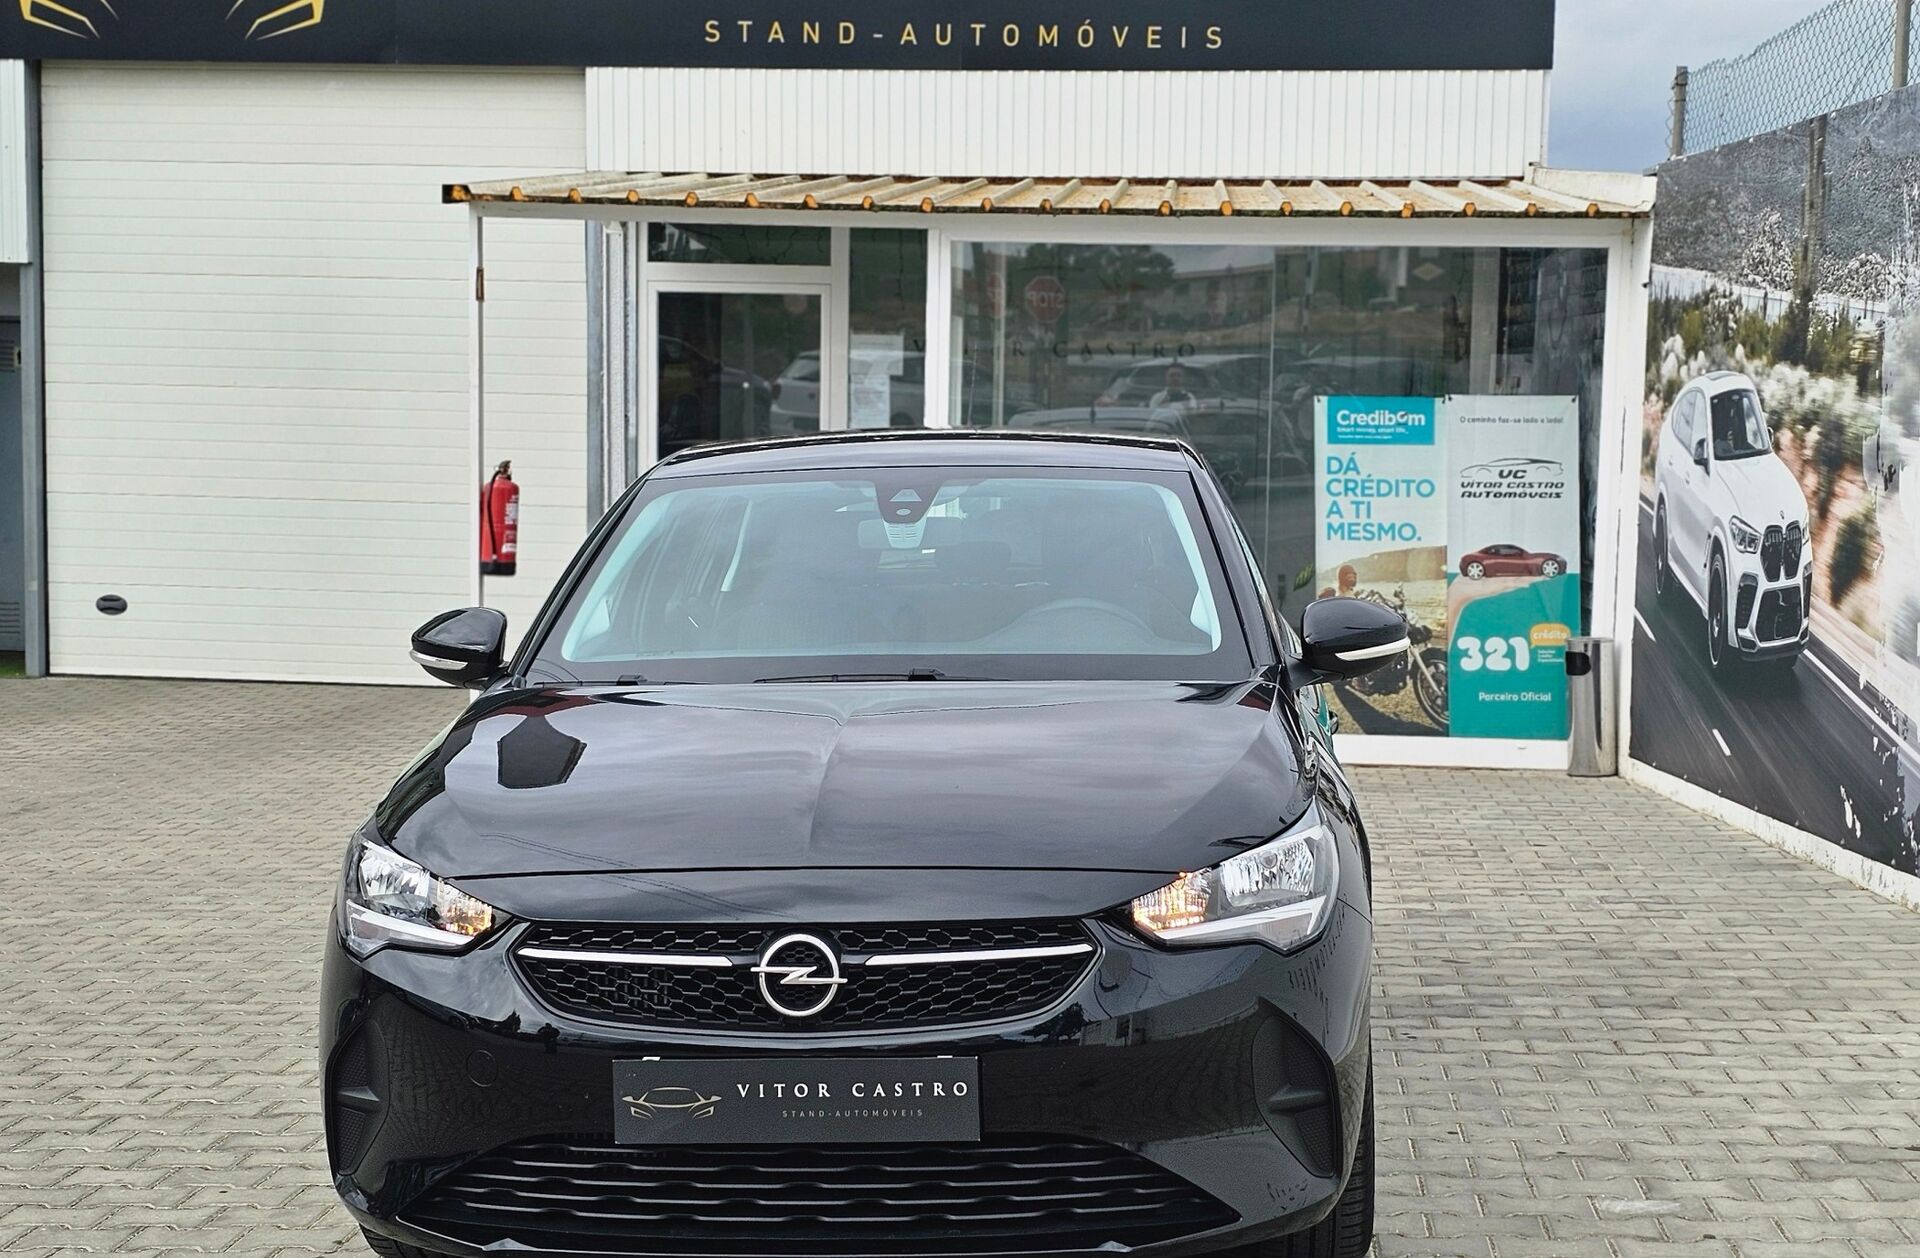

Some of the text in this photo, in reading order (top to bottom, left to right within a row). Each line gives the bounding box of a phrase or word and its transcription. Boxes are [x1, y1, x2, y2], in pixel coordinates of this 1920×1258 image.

[704, 19, 1223, 49] STAND-AUTOMÓVEIS
[1053, 341, 1196, 359] CASTRO
[1336, 409, 1426, 426] Credibom
[1326, 451, 1361, 475] DÁ
[1326, 474, 1436, 498] CRÉDITO
[1506, 481, 1565, 489] CASTRO
[1326, 500, 1372, 519] A TI
[1326, 522, 1422, 542] MESMO.
[1456, 636, 1530, 671] 321
[1478, 692, 1552, 702] Parceiro Oficial
[736, 1081, 969, 1098] VITOR CASTRO
[782, 1107, 924, 1118] STAND-AUTOMÓVEIS
